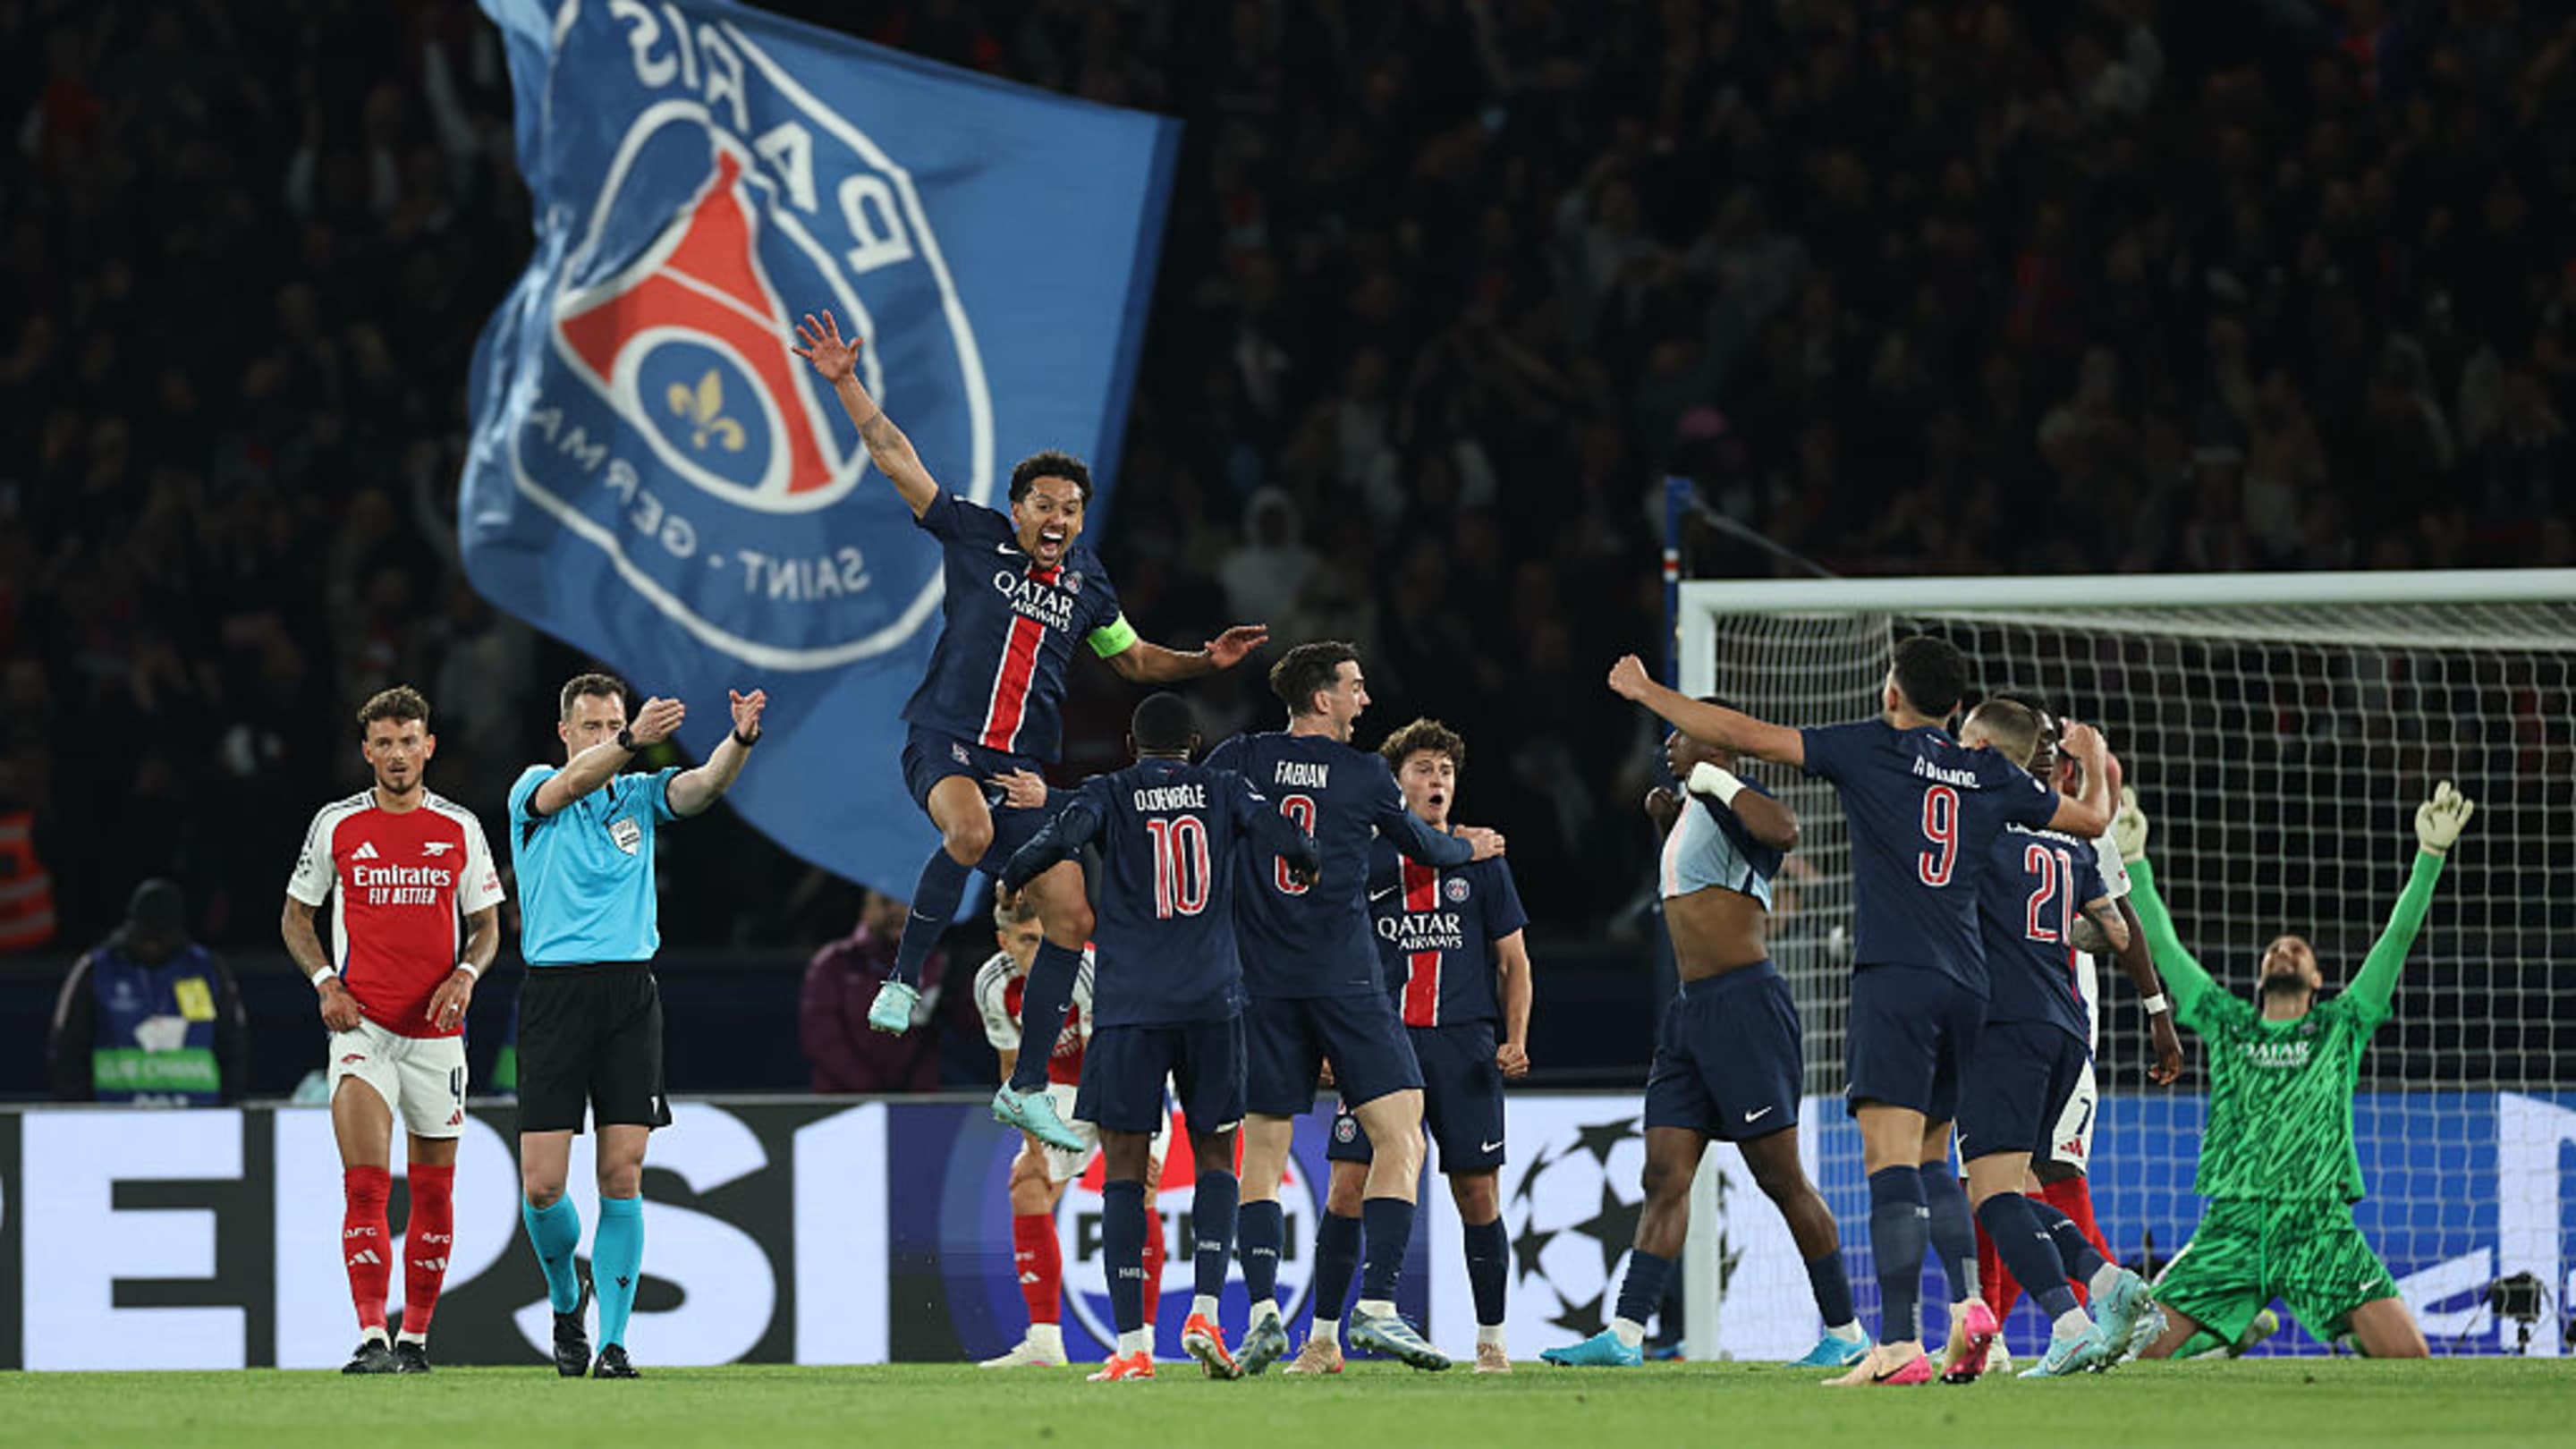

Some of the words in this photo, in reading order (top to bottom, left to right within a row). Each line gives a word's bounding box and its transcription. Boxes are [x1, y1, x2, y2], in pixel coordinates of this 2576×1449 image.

[993, 570, 1073, 619] QATAR
[1010, 597, 1071, 633] AIRWAYS
[1919, 784, 1961, 887] 9
[352, 863, 452, 887] Emirates
[1146, 814, 1212, 919] 10
[369, 886, 390, 905] FLY
[392, 886, 437, 905] BETTER
[2024, 843, 2074, 946] 21
[1377, 912, 1462, 942] QATAR
[1399, 935, 1463, 950] AIRWAYS
[450, 1065, 462, 1106] 4
[2075, 1097, 2092, 1135] 7
[0, 1104, 888, 1369] EPSI
